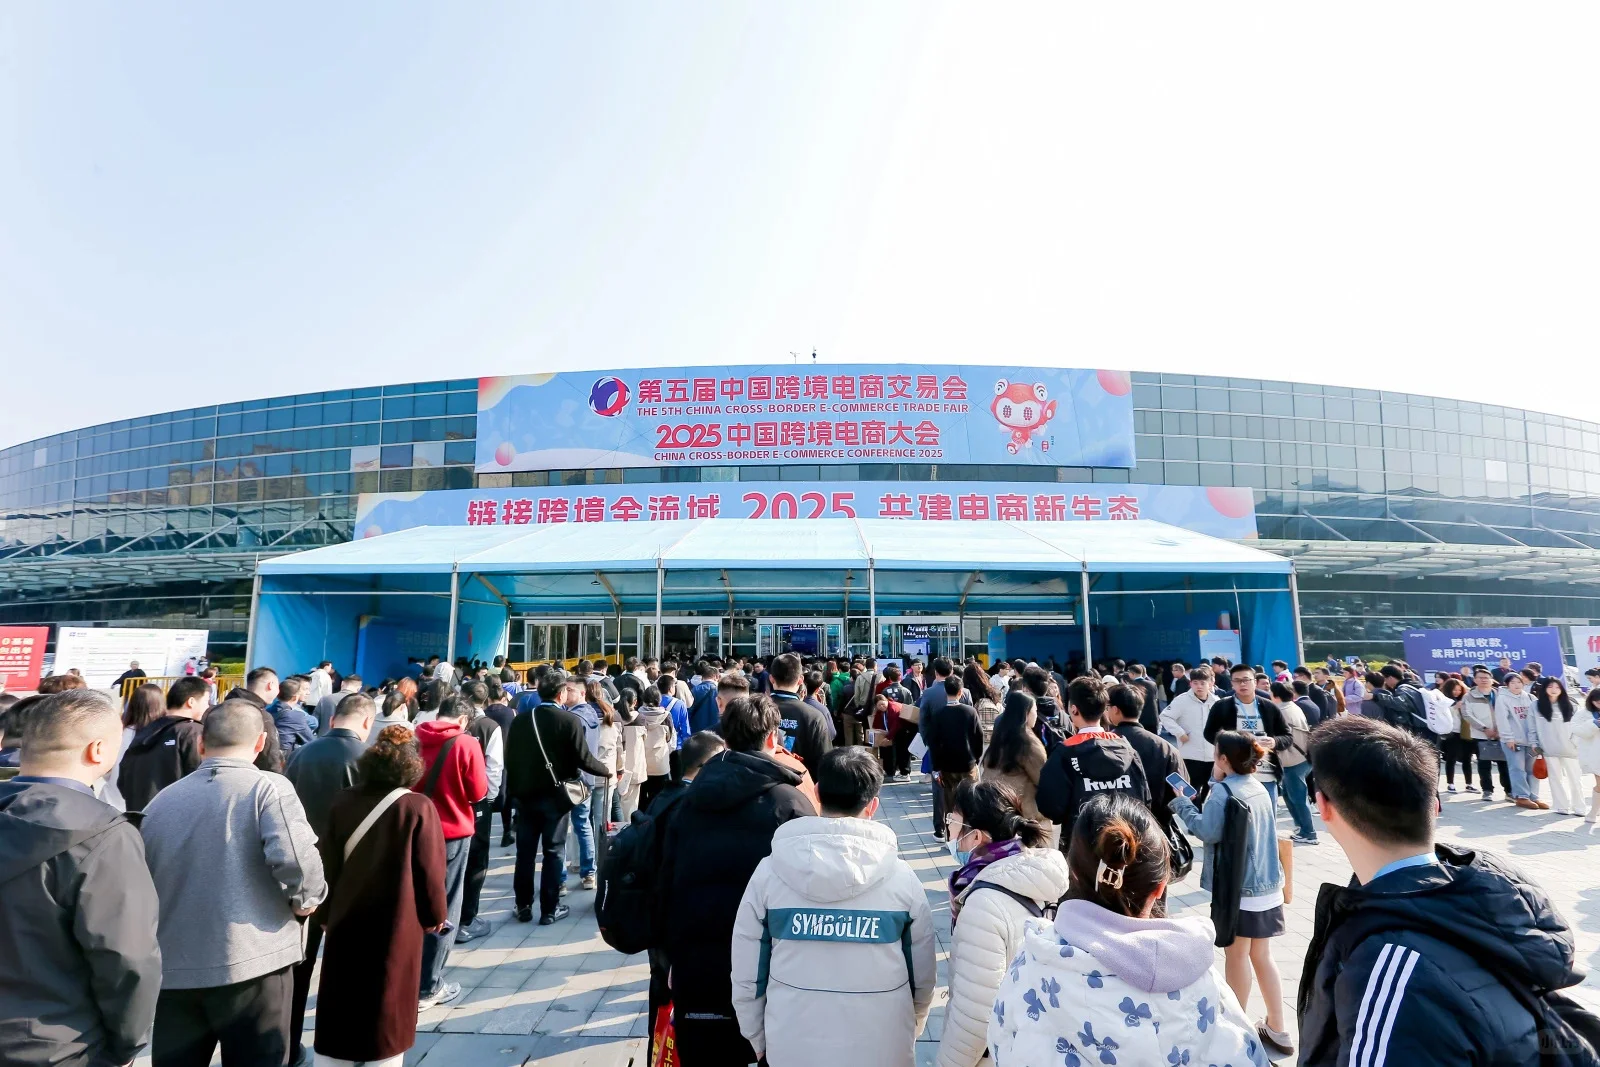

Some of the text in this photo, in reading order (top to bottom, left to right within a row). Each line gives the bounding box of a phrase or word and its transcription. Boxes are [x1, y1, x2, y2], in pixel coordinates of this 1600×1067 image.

[638, 374, 968, 404] 第五届中国跨境电商交易会
[637, 402, 969, 416] THE 5TH CHINA CROSS-BORDER E-COMMERCE TRADE FAIR
[654, 448, 943, 461] CHINA CROSS-BORDER E-COMMERCE CONFERENCE 2025
[467, 494, 720, 526] 链接跨境全流域
[742, 492, 856, 519] 2025
[792, 913, 880, 939] SYMBOLIZE
